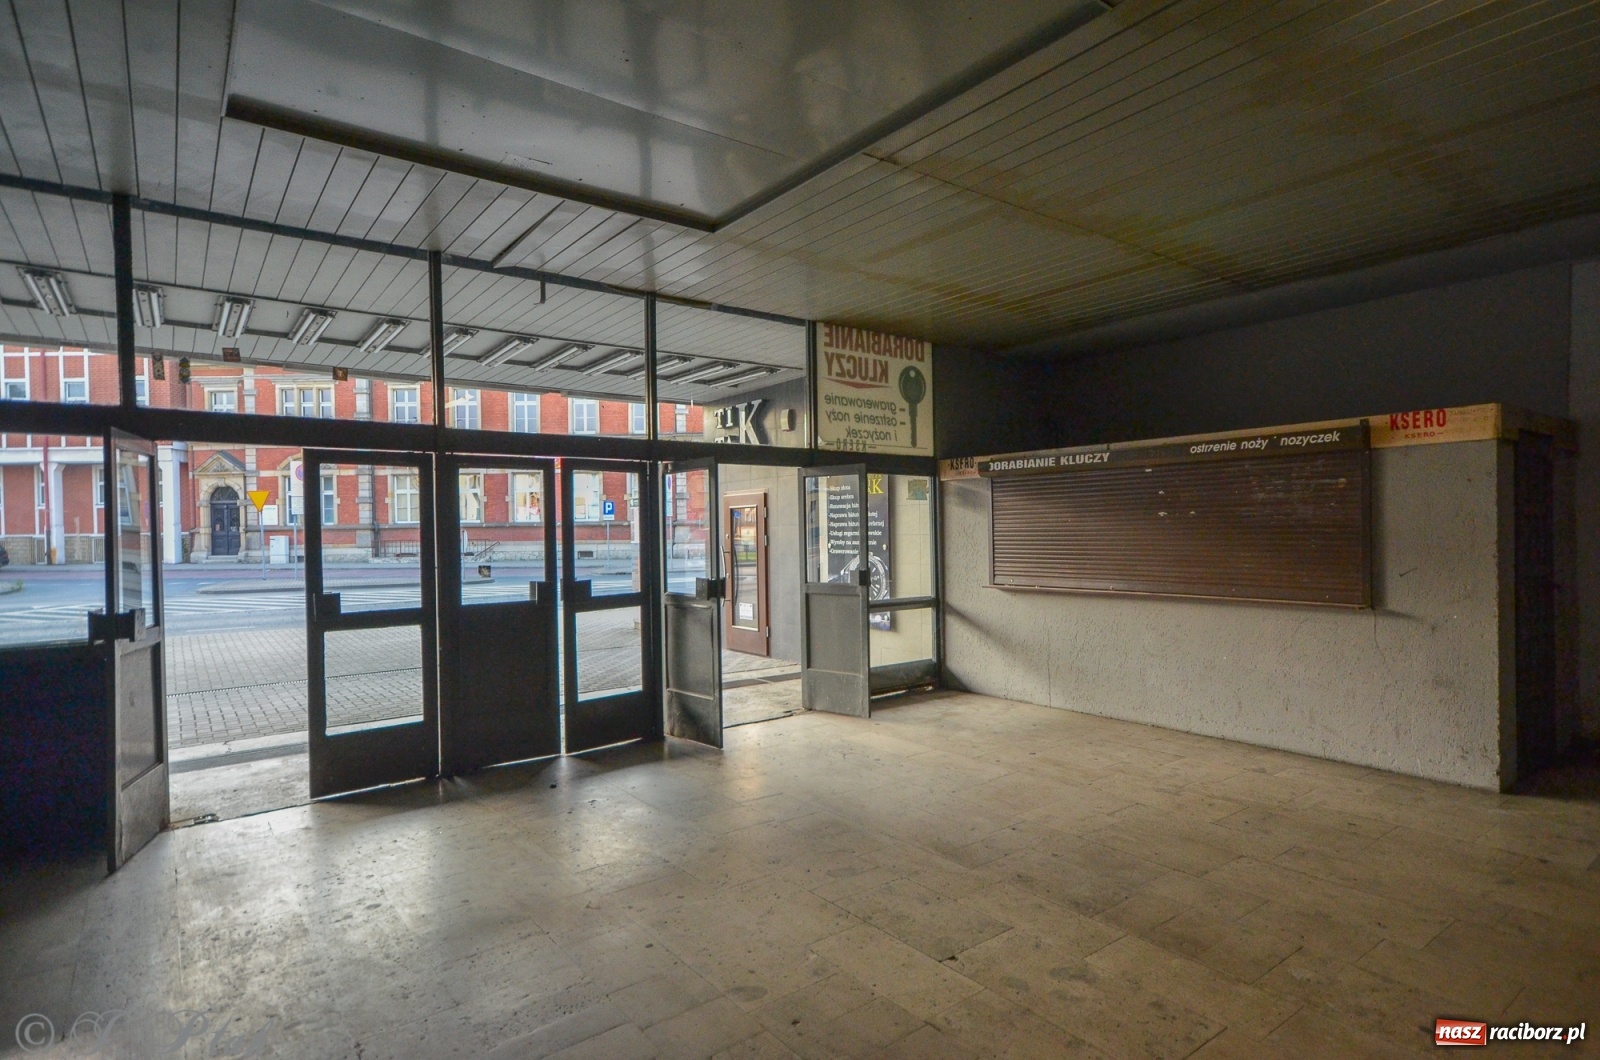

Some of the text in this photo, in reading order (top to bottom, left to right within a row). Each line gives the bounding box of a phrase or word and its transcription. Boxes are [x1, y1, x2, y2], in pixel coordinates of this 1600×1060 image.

[1389, 408, 1447, 432] KSERO
[1404, 431, 1436, 440] KSERO
[1240, 437, 1269, 450] noży
[1060, 452, 1111, 466] KLUCZY
